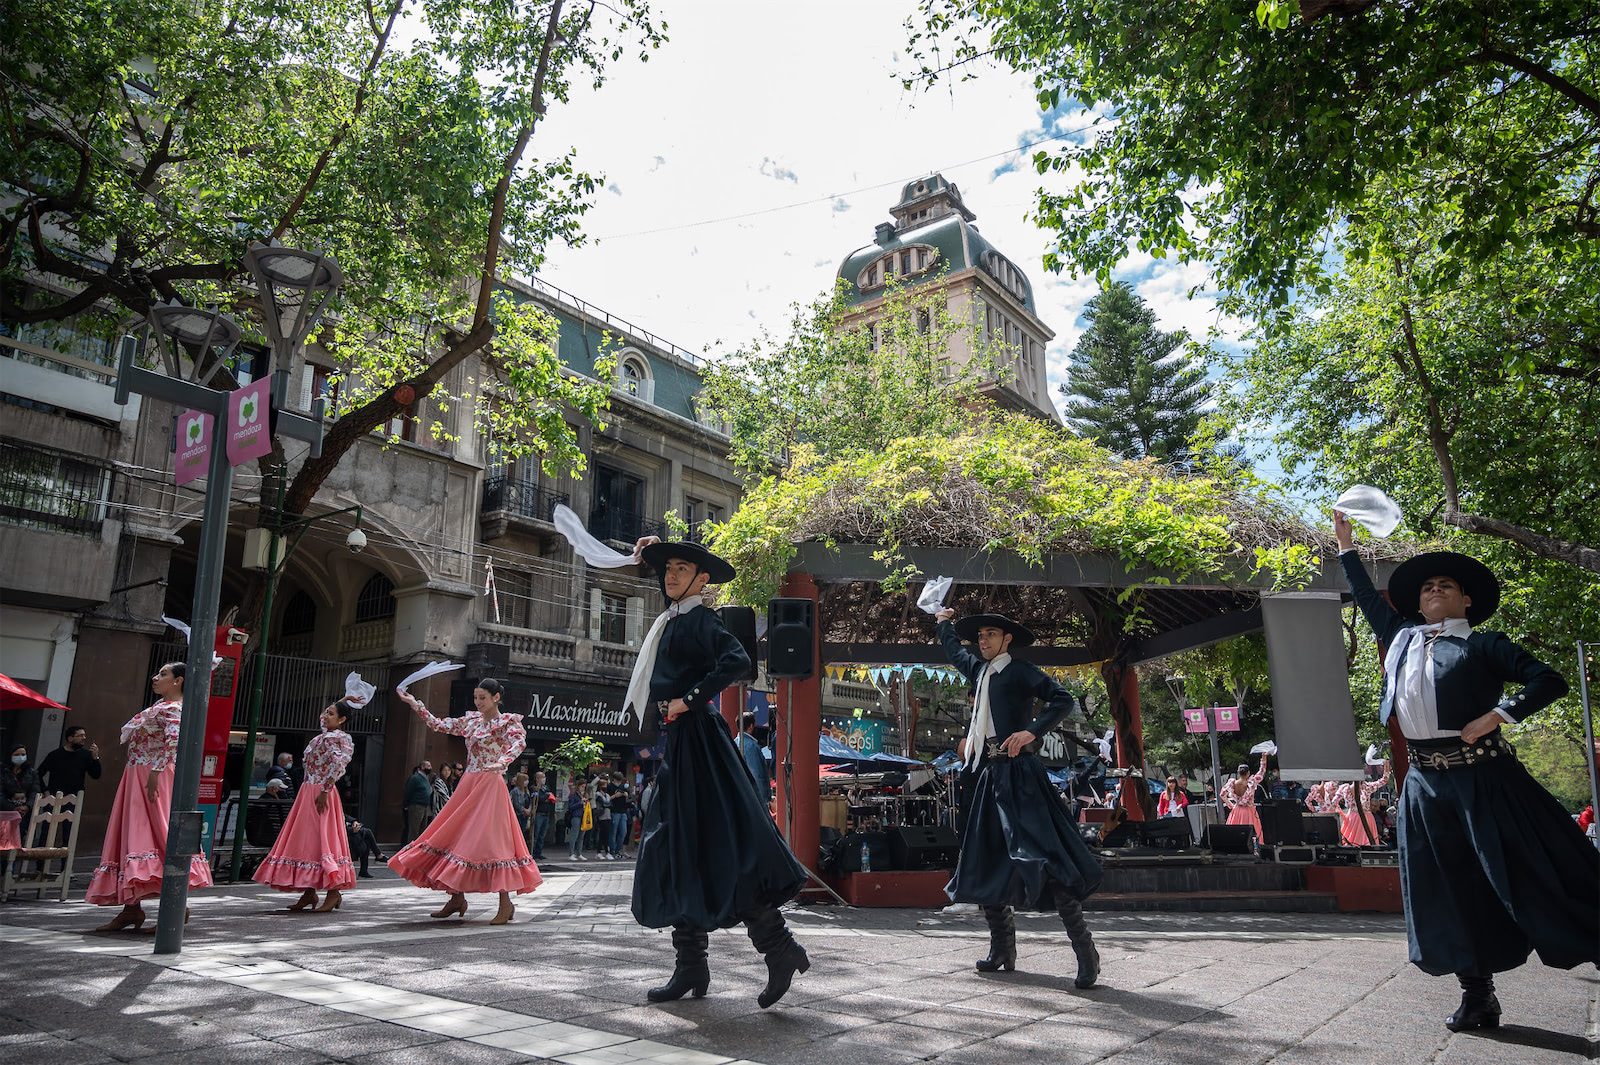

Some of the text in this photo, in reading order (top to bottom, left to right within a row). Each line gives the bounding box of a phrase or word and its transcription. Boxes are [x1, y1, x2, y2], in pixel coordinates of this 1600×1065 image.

[233, 423, 262, 440] mendoza
[181, 444, 208, 460] mendoza
[47, 713, 57, 722] 49
[528, 693, 631, 726] Maximiliano
